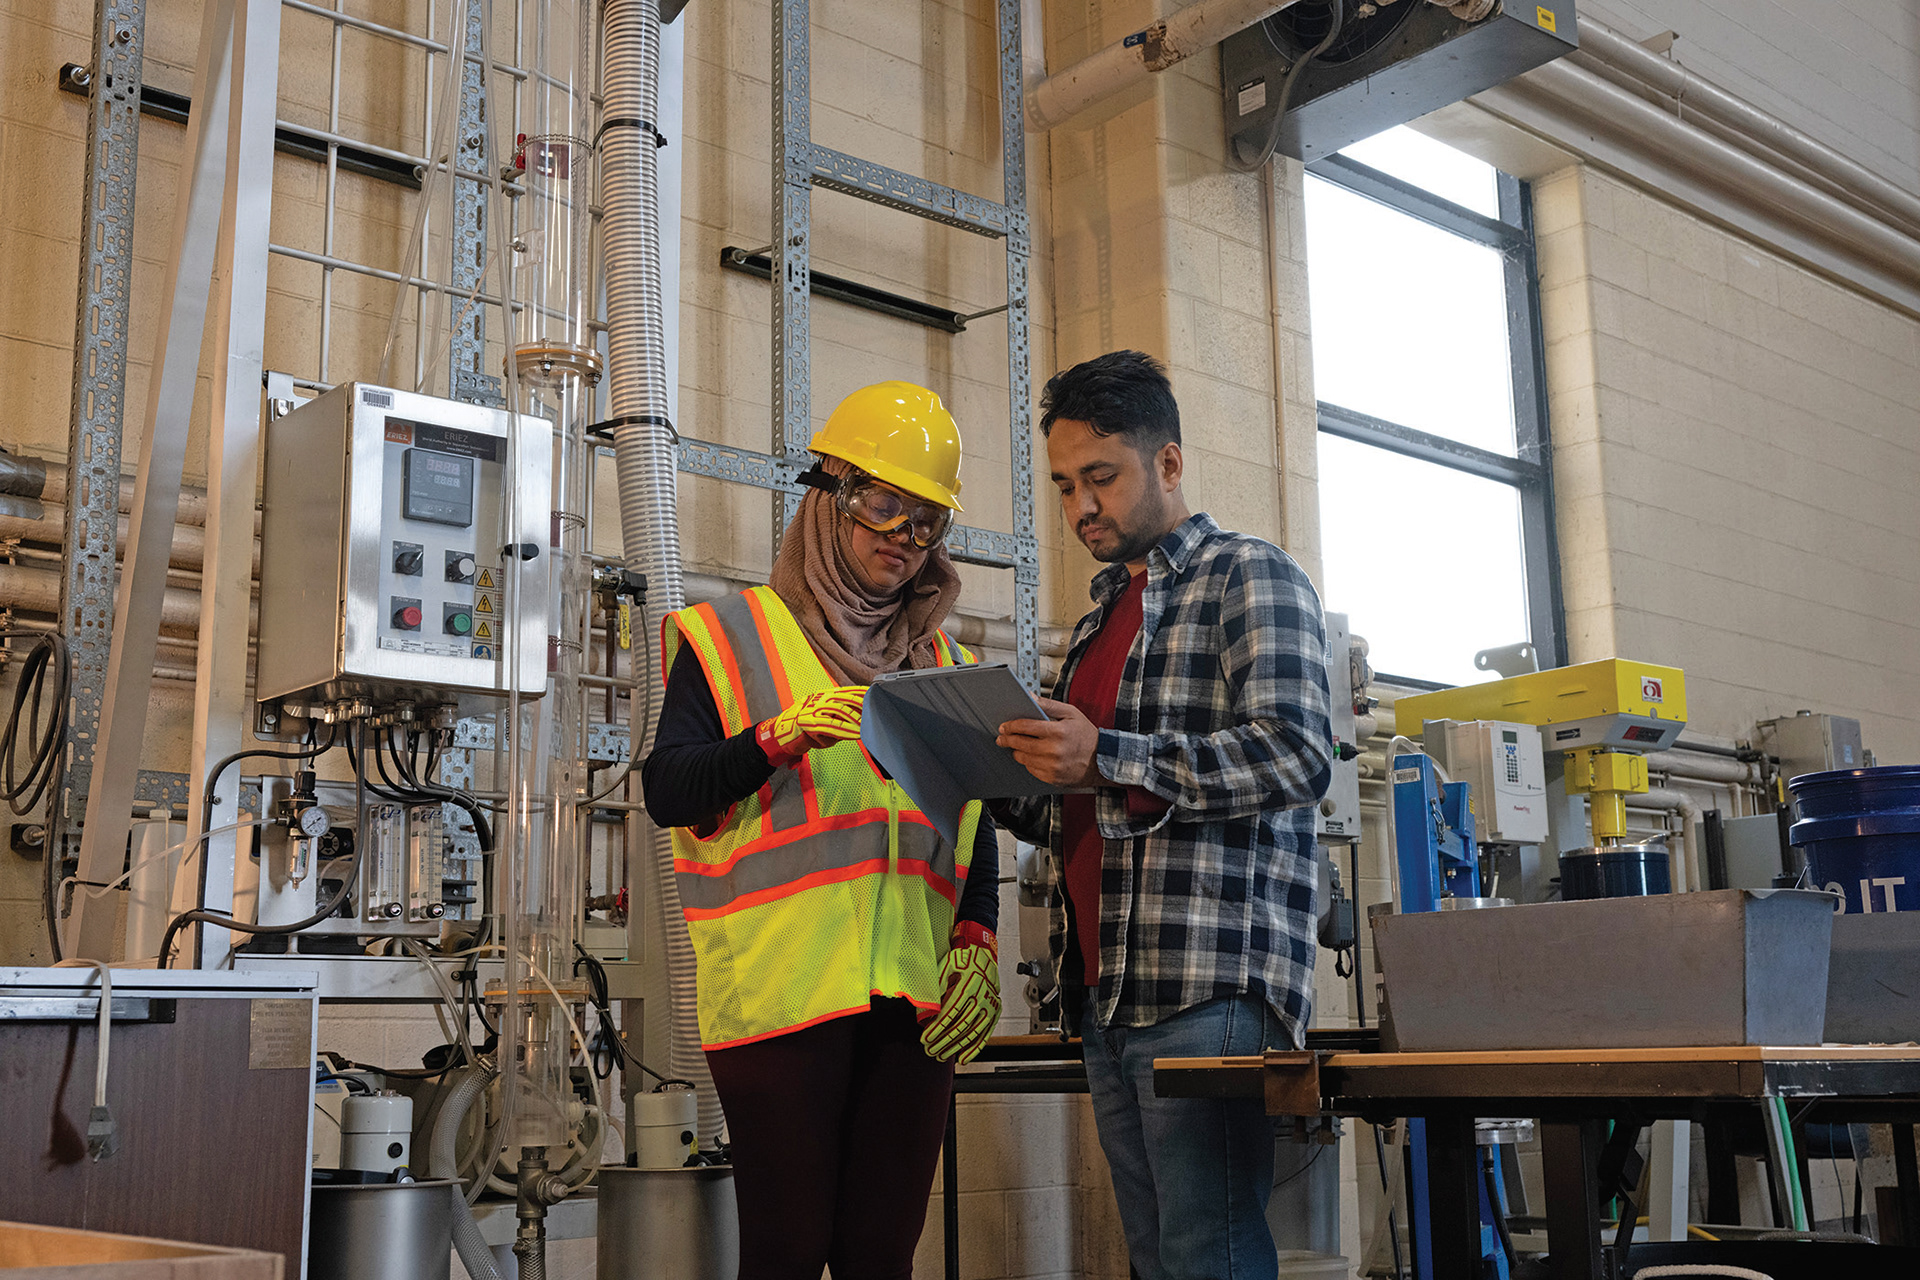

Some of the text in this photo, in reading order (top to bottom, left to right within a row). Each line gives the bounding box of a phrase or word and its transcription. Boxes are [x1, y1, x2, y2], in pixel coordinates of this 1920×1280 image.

[386, 431, 408, 441] ERIEZ
[444, 431, 469, 443] ERIEZ
[1859, 876, 1905, 914] IT
